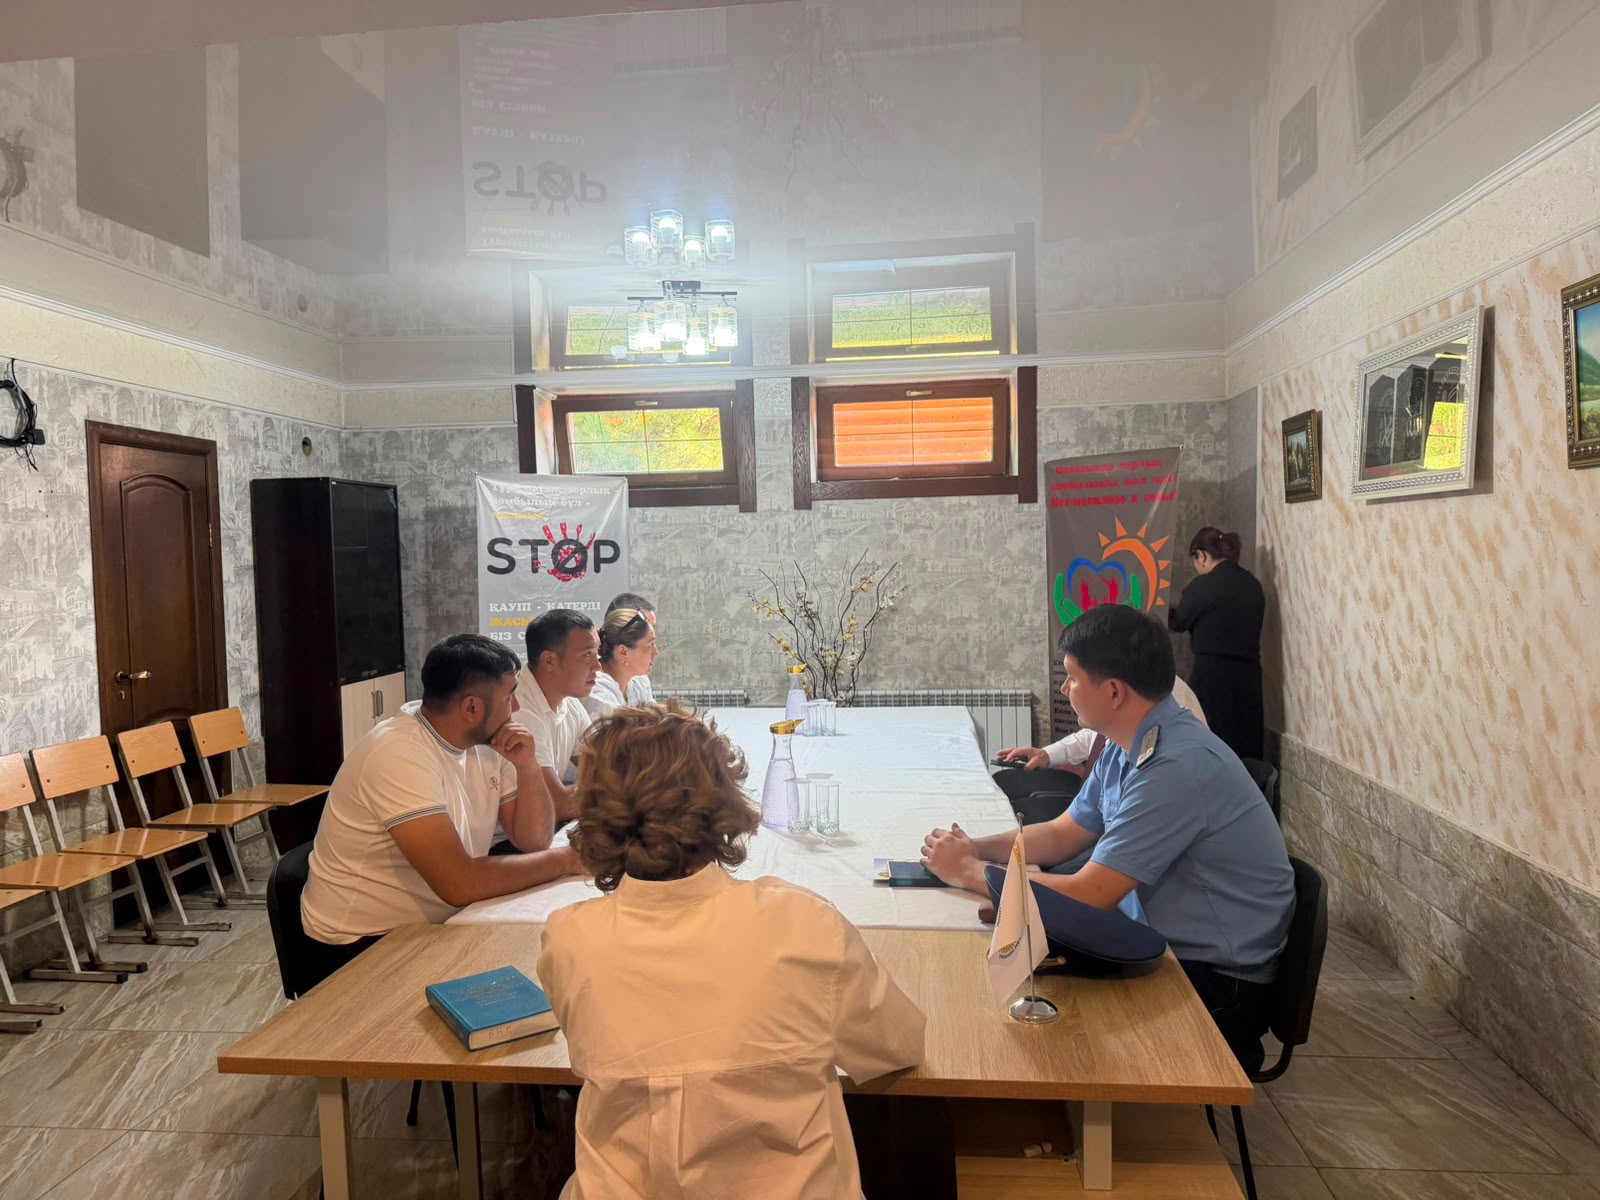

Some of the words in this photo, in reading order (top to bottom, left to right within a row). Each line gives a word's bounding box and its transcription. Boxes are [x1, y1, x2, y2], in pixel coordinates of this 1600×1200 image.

[486, 537, 621, 575] STOP
[490, 617, 535, 627] ЖАСЫ
[490, 631, 512, 641] БІЗ
